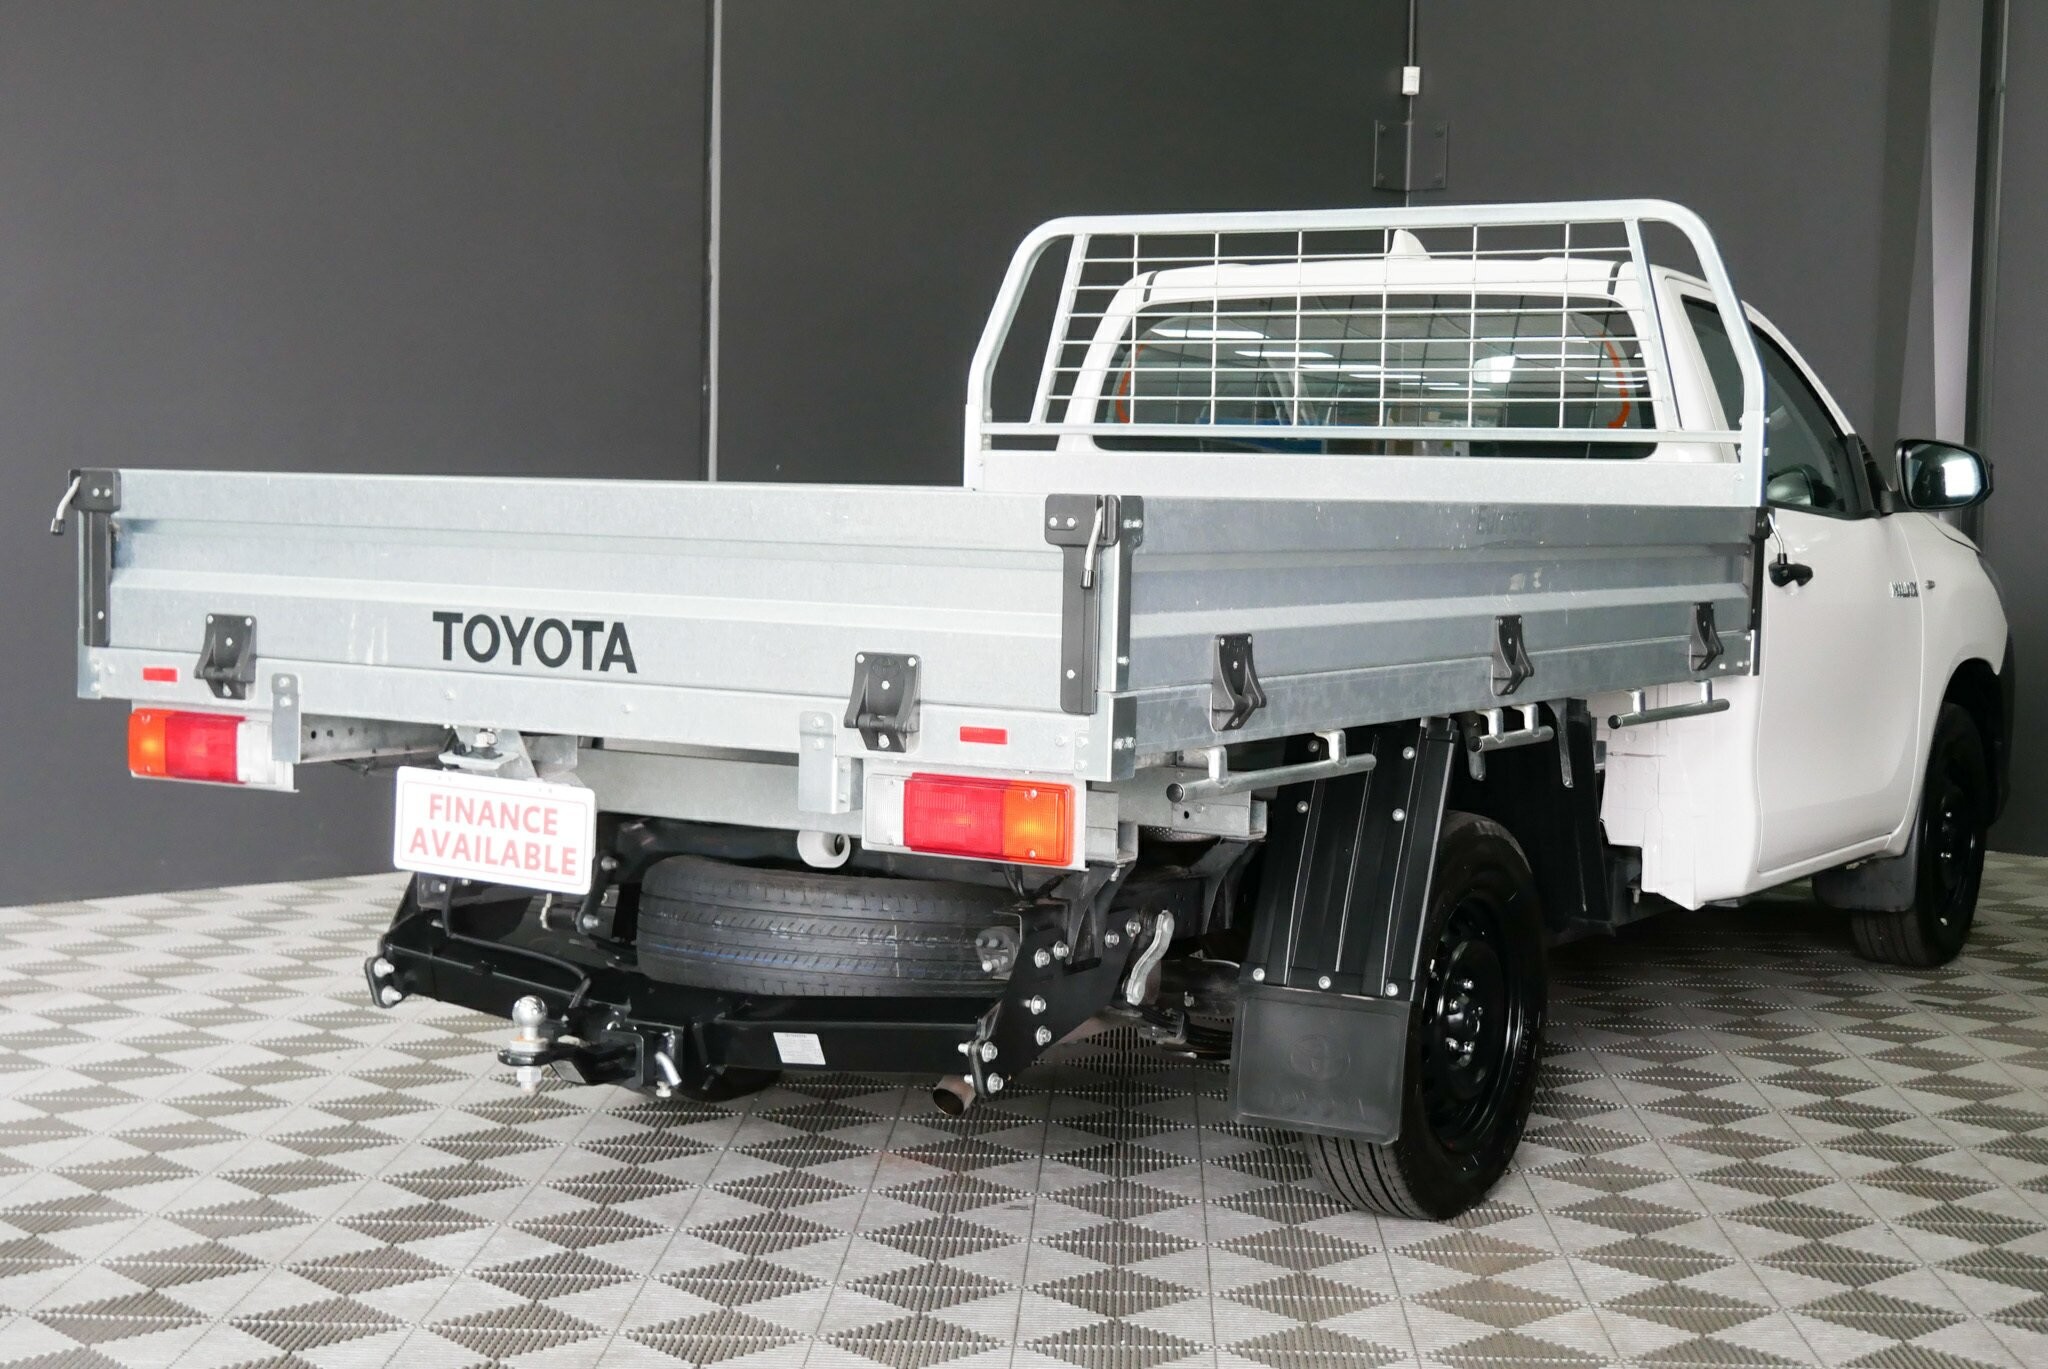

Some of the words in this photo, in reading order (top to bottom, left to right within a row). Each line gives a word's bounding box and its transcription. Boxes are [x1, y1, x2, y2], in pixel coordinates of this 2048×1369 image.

[433, 611, 637, 674] TOYOTA
[429, 793, 558, 836] FINANCE
[409, 827, 577, 876] AVAILABLE
